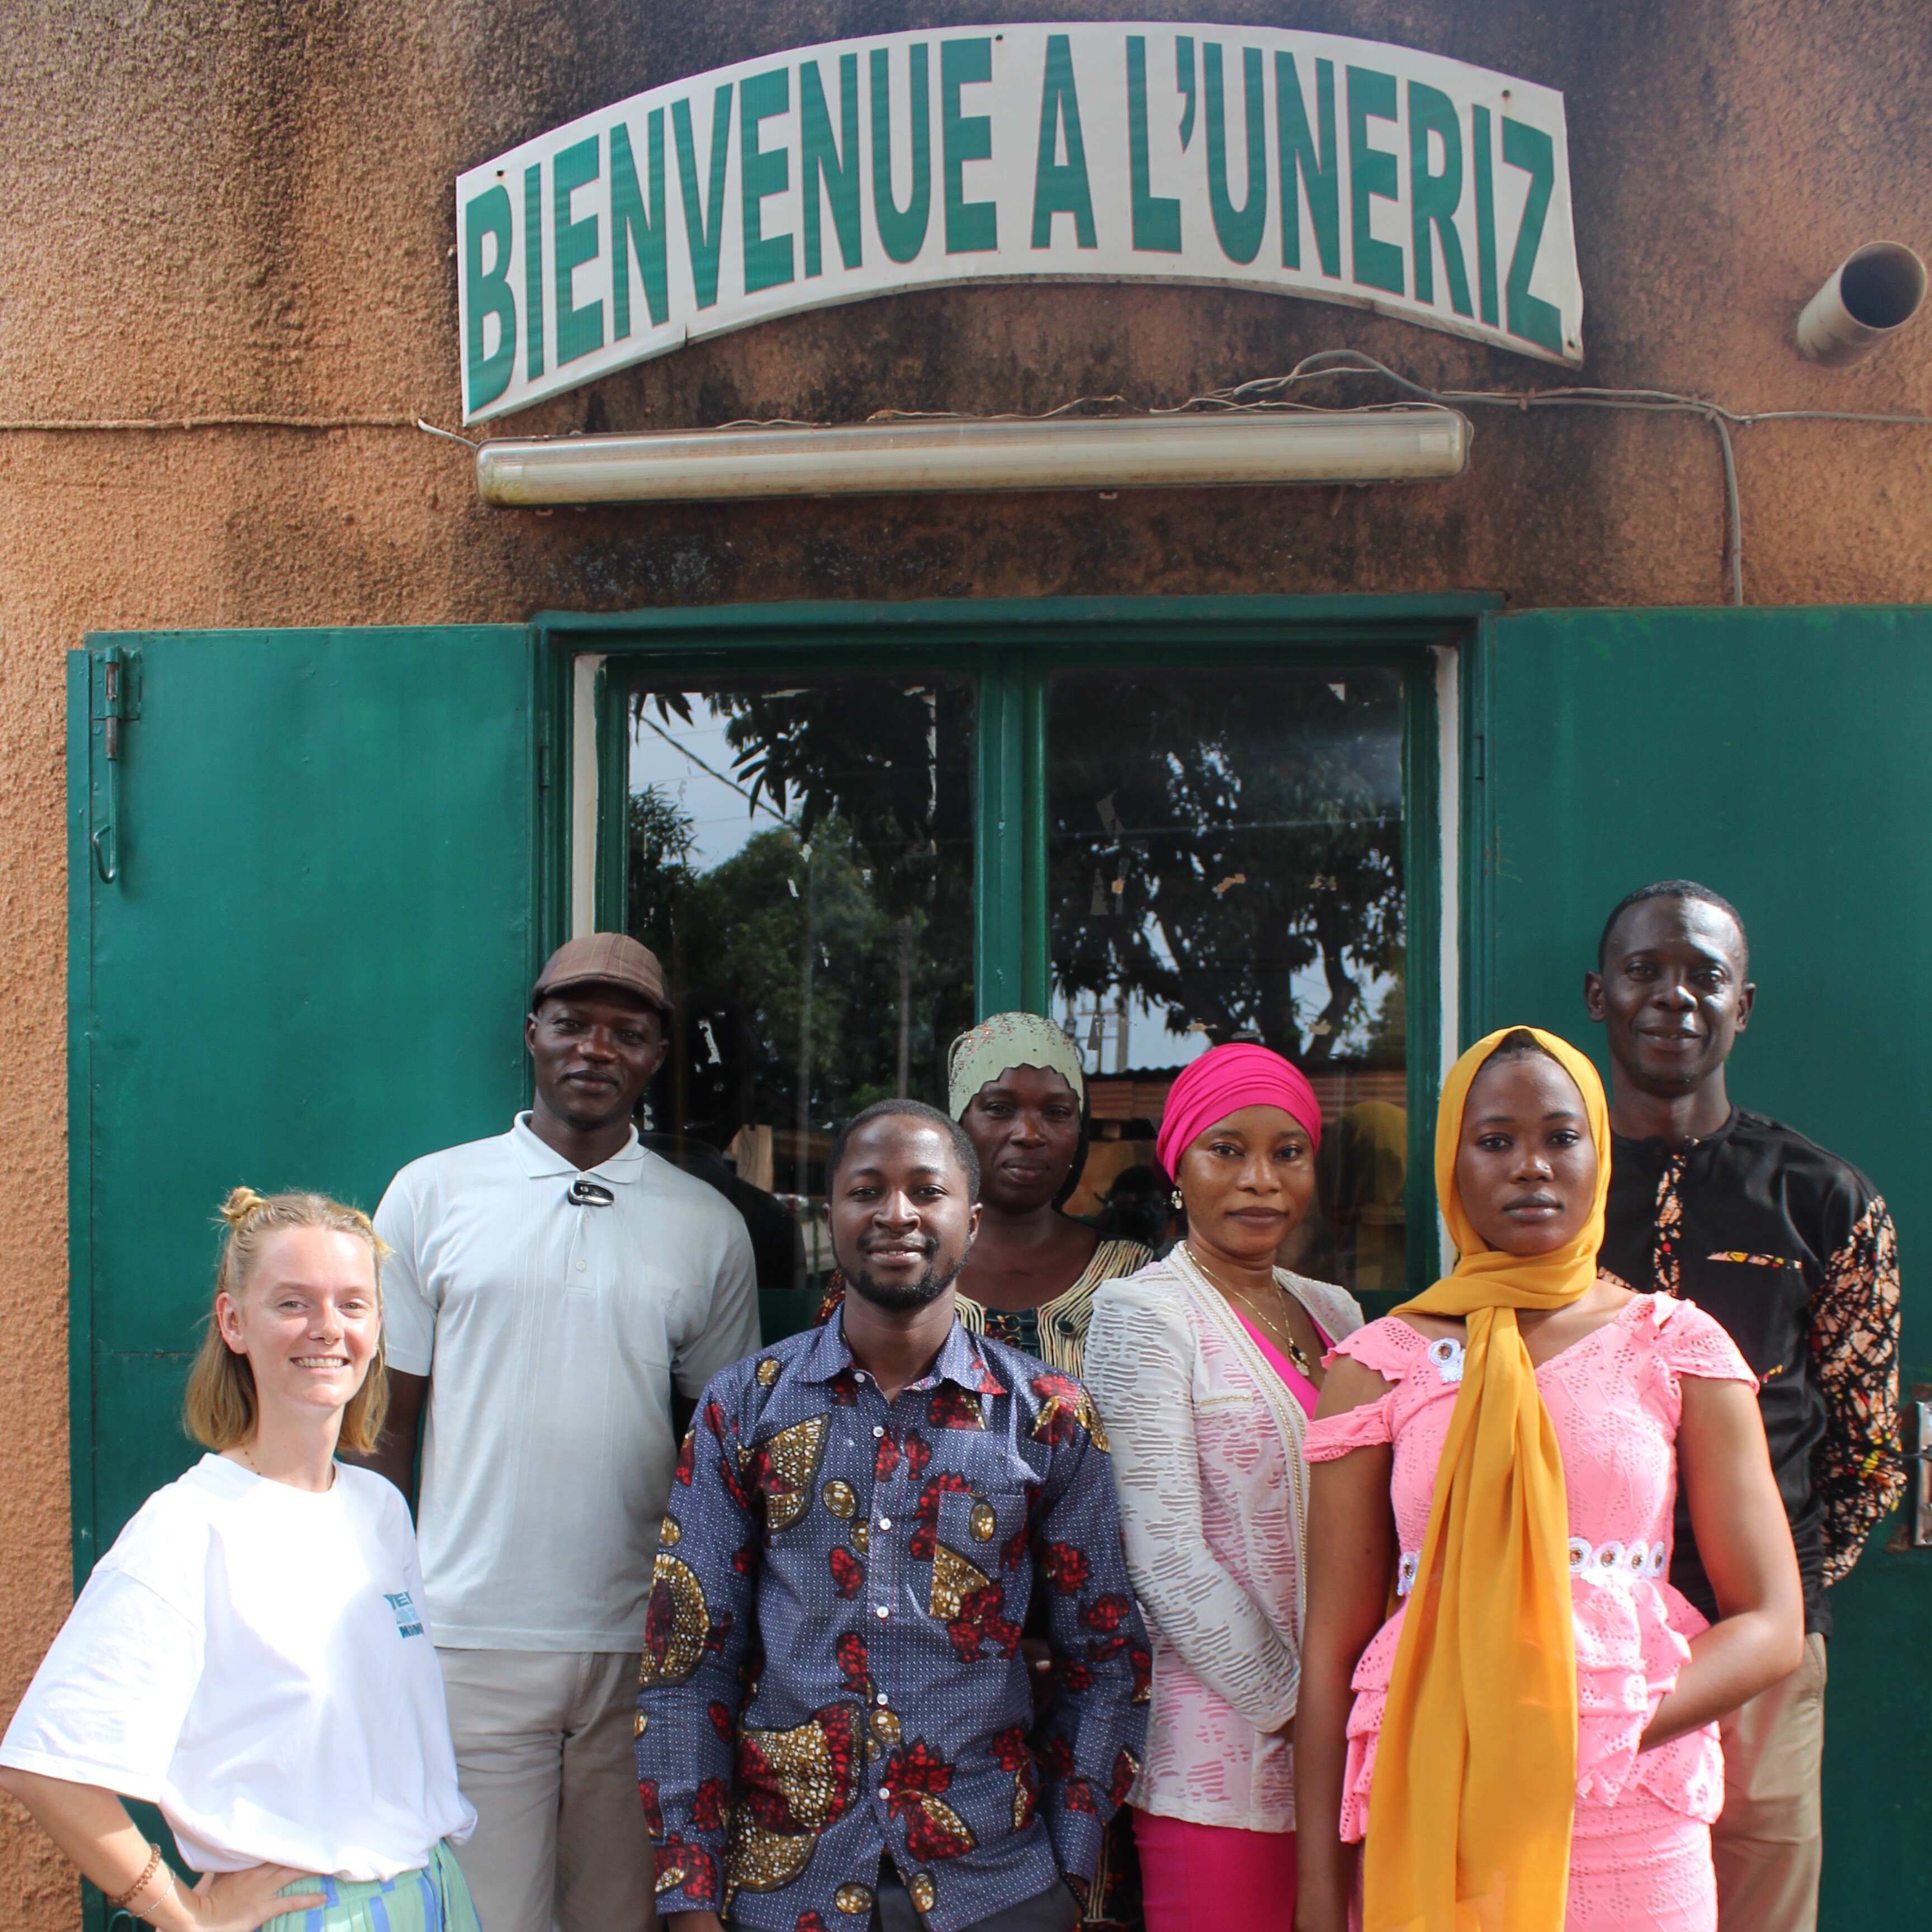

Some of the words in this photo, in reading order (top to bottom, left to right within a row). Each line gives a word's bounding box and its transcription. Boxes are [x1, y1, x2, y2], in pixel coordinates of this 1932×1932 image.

[465, 36, 997, 414] BIENVENUE
[1031, 33, 1097, 247] A
[1127, 35, 1563, 350] L'UNERIZ
